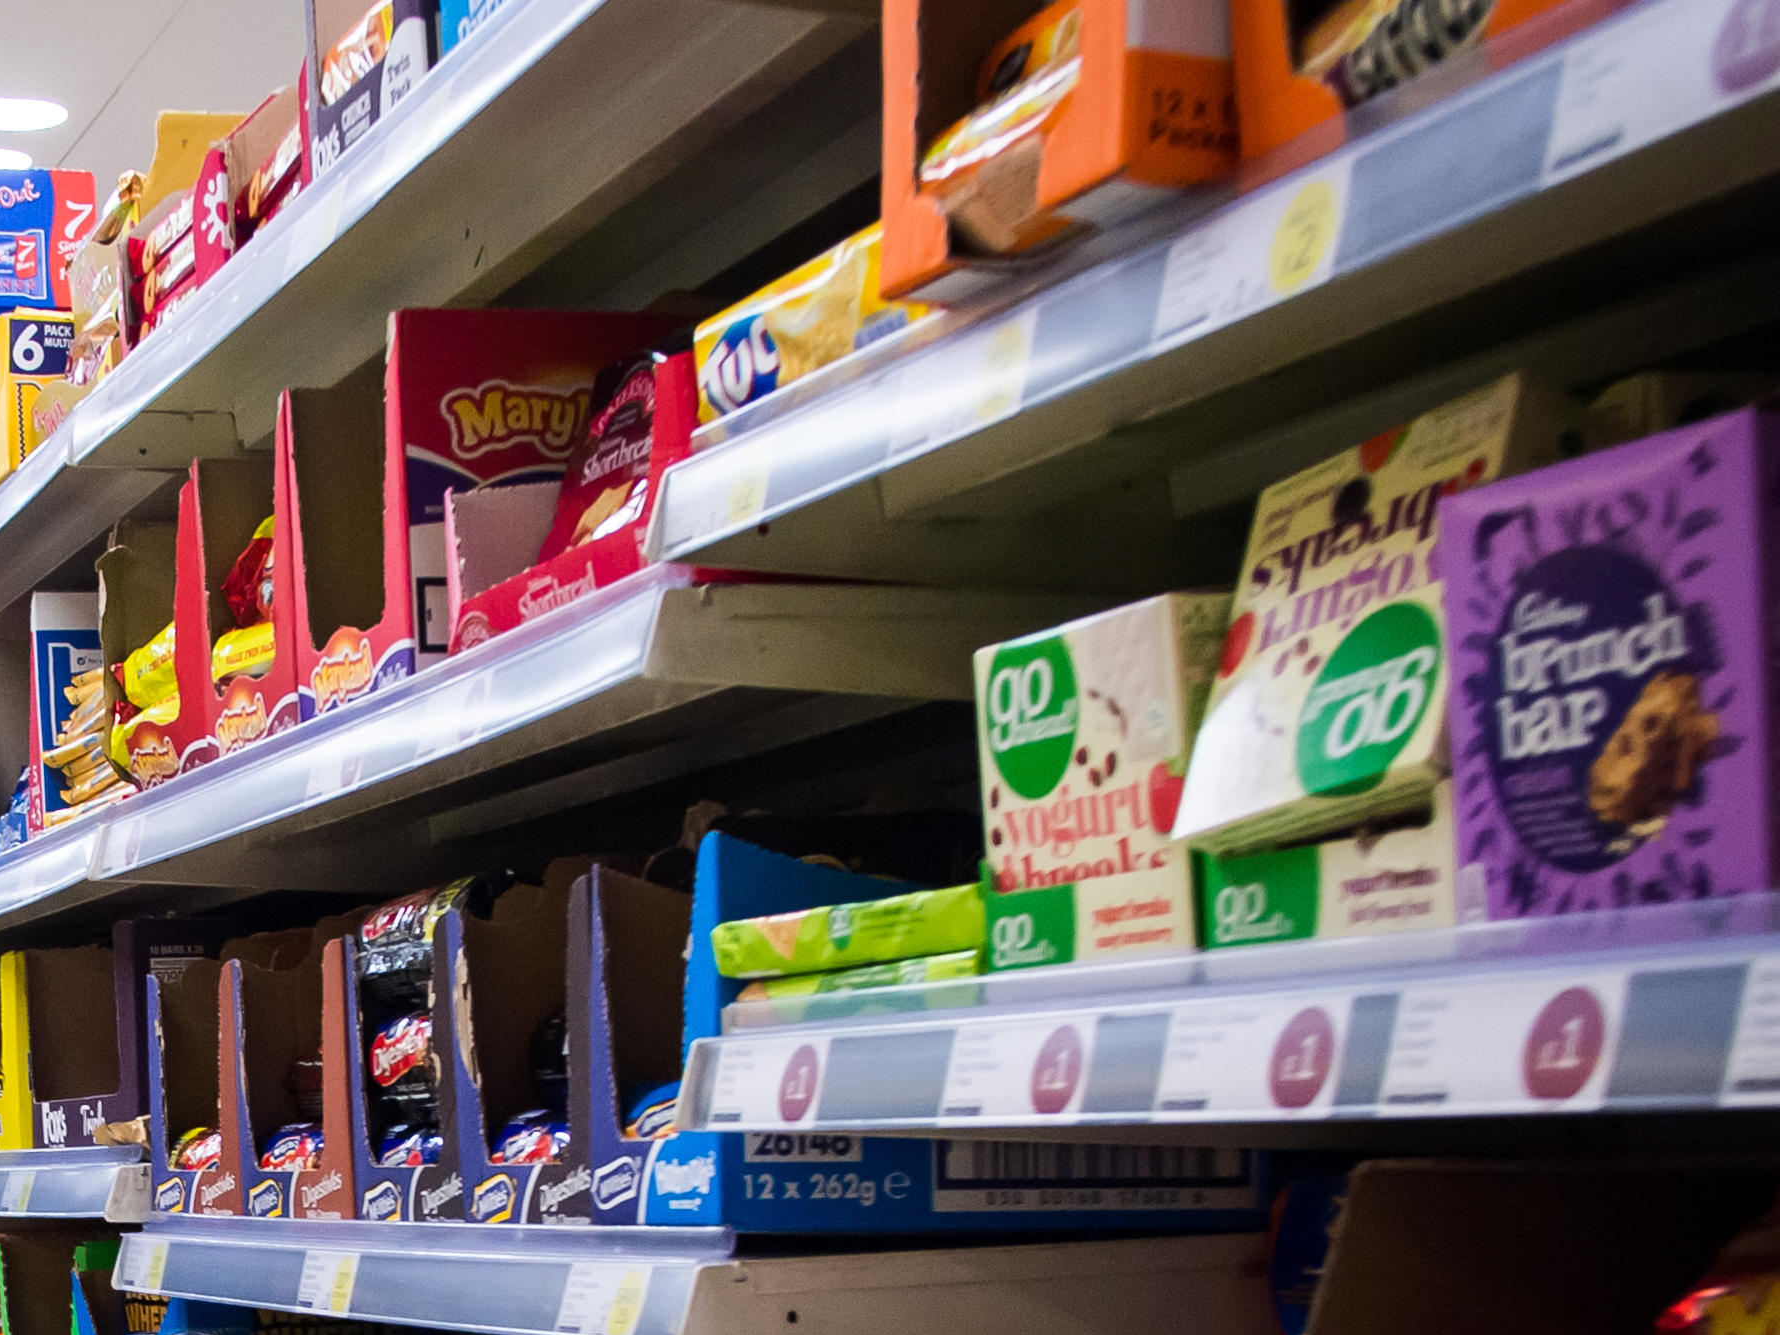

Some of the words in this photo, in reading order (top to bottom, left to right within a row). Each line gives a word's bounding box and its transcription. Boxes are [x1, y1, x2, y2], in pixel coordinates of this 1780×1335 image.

[65, 200, 93, 239] 7
[17, 240, 35, 262] 7
[13, 324, 45, 371] 6
[44, 324, 72, 337] PACK
[1500, 594, 1686, 692] brunch
[989, 658, 1053, 753] go
[1496, 688, 1607, 760] bar
[1001, 780, 1149, 858] yogurt
[743, 1174, 774, 1200] 12
[783, 1183, 800, 1199] x
[813, 1172, 876, 1207] 262g
